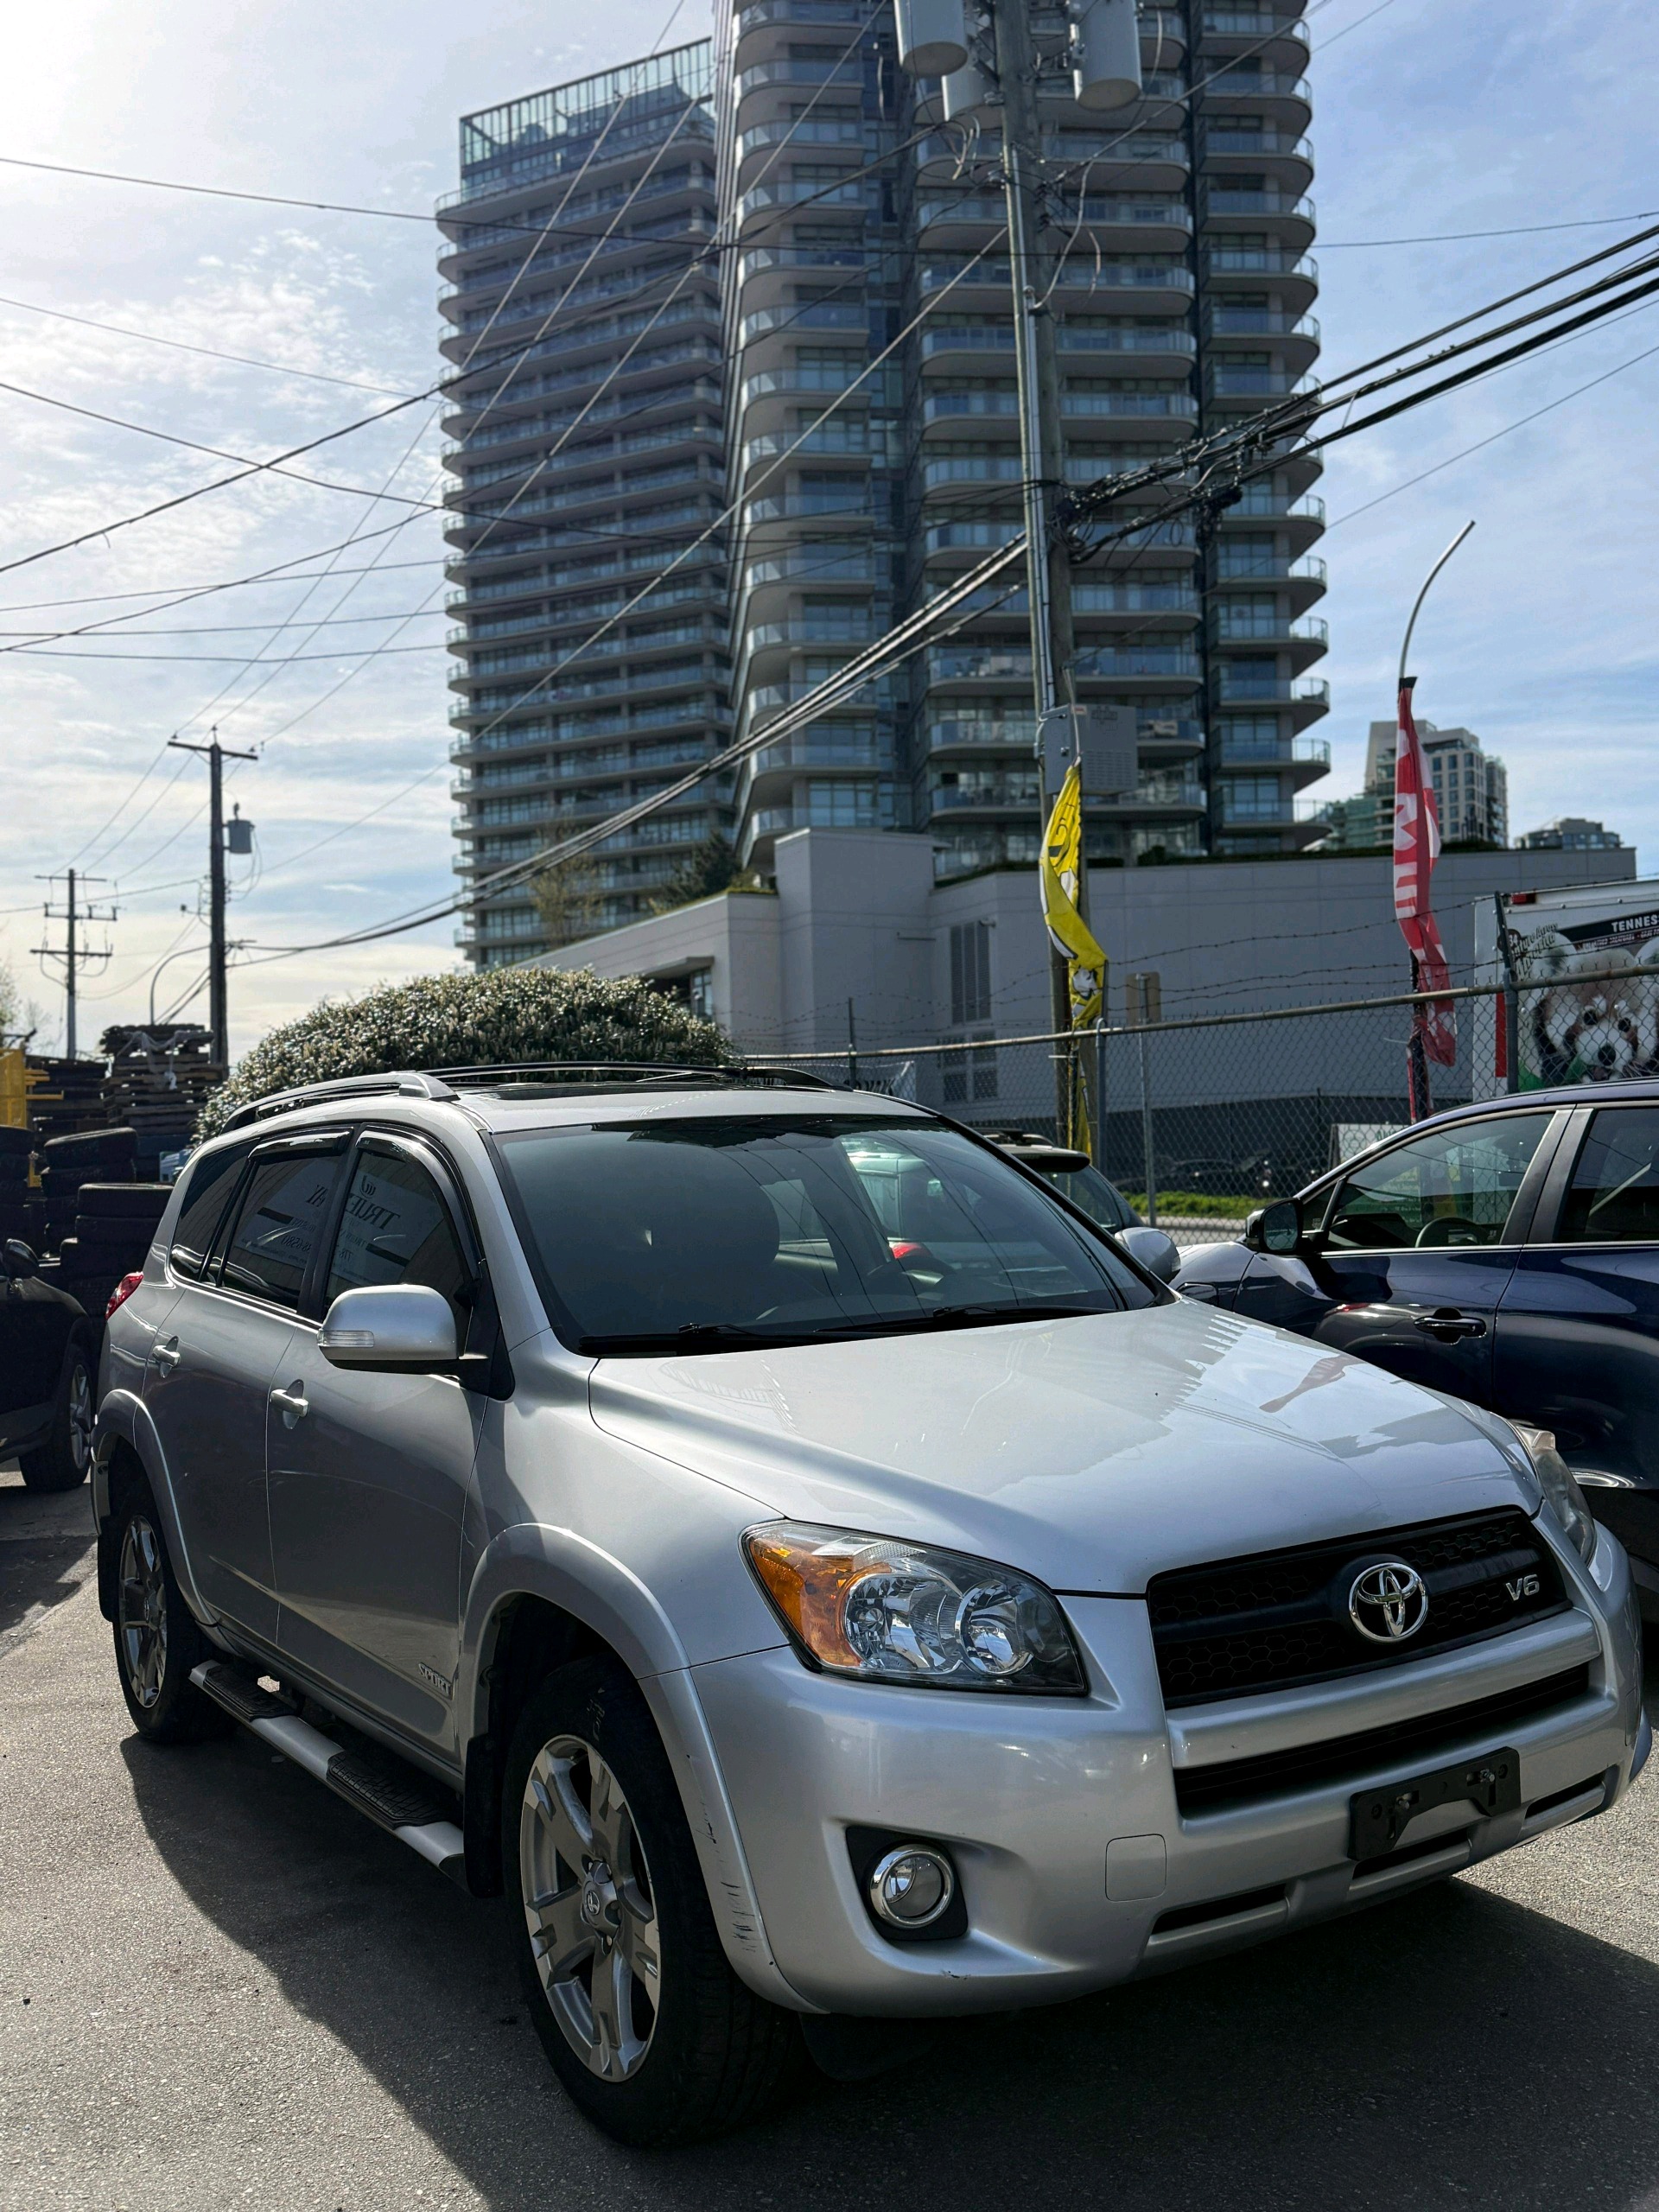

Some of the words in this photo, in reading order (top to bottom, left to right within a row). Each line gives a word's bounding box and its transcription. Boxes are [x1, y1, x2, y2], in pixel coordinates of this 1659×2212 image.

[1611, 914, 1659, 932] TENNES
[1505, 1573, 1540, 1601] V6
[418, 1662, 451, 1696] SPORT
